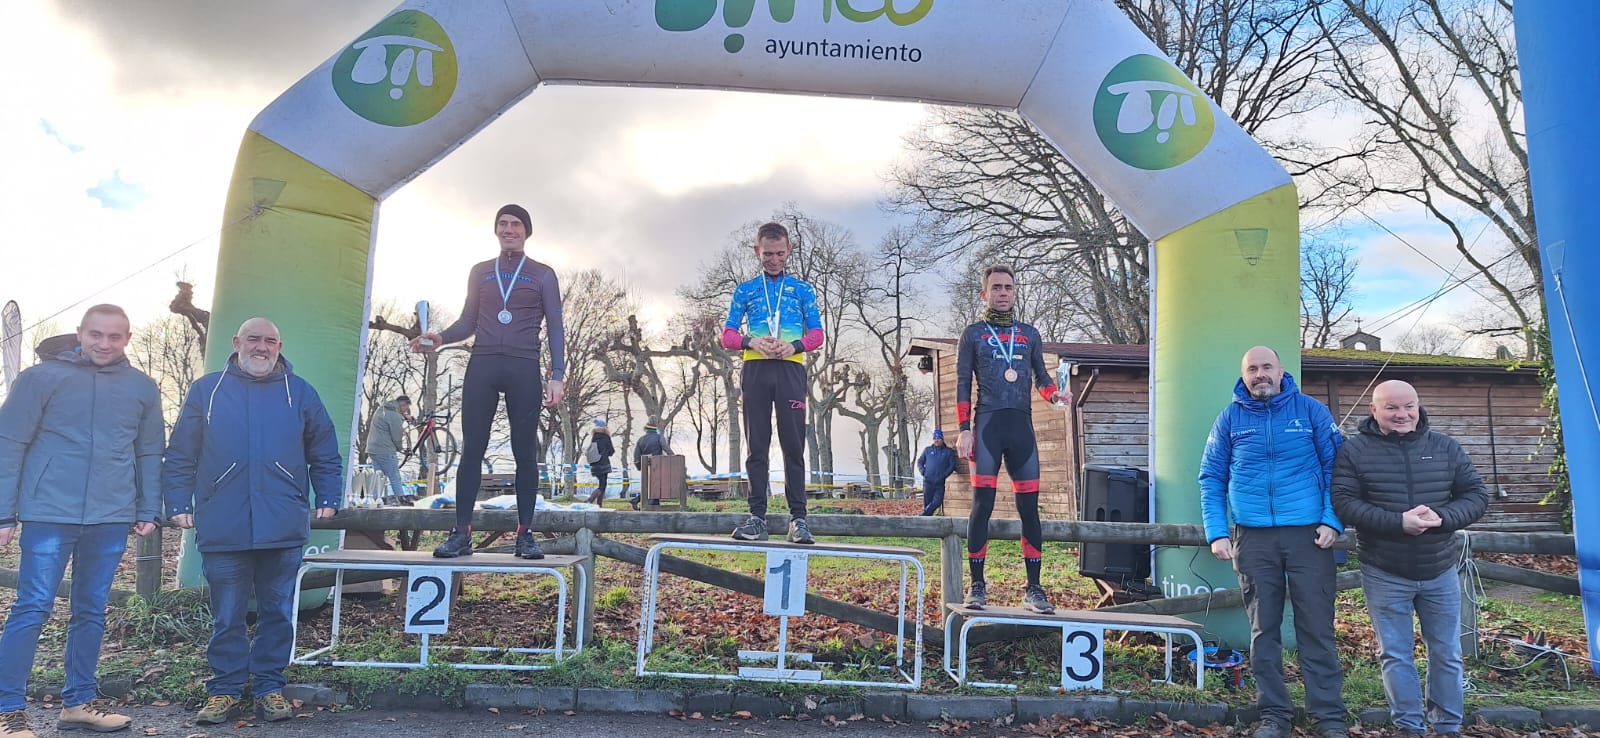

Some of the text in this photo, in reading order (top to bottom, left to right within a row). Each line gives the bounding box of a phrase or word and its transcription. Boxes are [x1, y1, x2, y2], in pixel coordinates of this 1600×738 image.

[765, 37, 922, 63] ayuntamiento
[409, 575, 446, 626] 2
[769, 559, 792, 610] 1
[1065, 630, 1100, 682] 3
